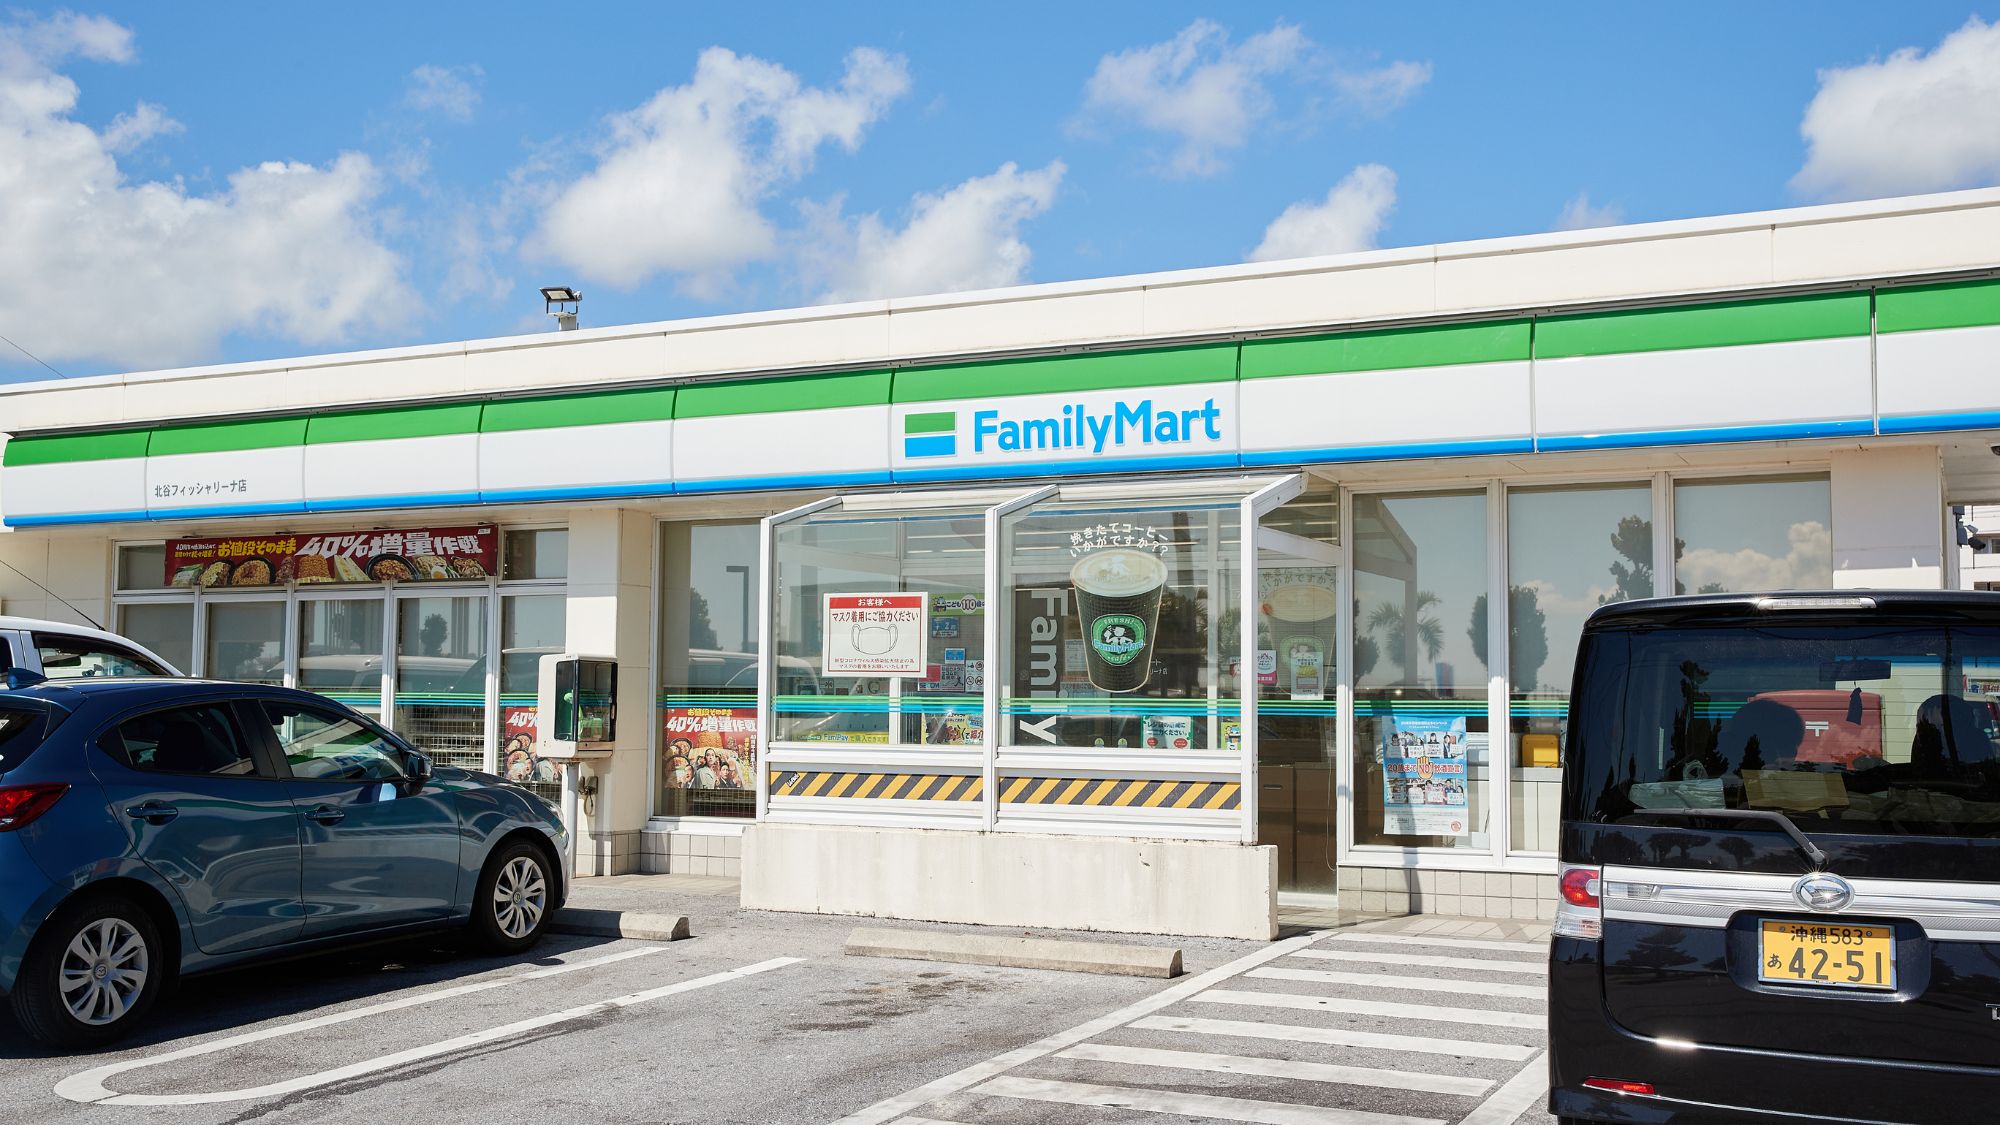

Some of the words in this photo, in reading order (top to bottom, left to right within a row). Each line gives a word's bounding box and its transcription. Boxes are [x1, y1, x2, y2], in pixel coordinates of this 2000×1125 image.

[974, 398, 1221, 454] FamilyMart
[155, 479, 247, 498] 北谷フィッシャリーナ店
[1070, 522, 1168, 545] 挽きたてコーヒー
[217, 538, 297, 557] お値段そのまま
[294, 532, 484, 560] 40%増量作戦
[858, 598, 893, 607] お客様へ
[832, 610, 919, 623] マスク着用にご協力ください
[1767, 953, 1782, 969] あ
[1788, 947, 1883, 984] 42-51
